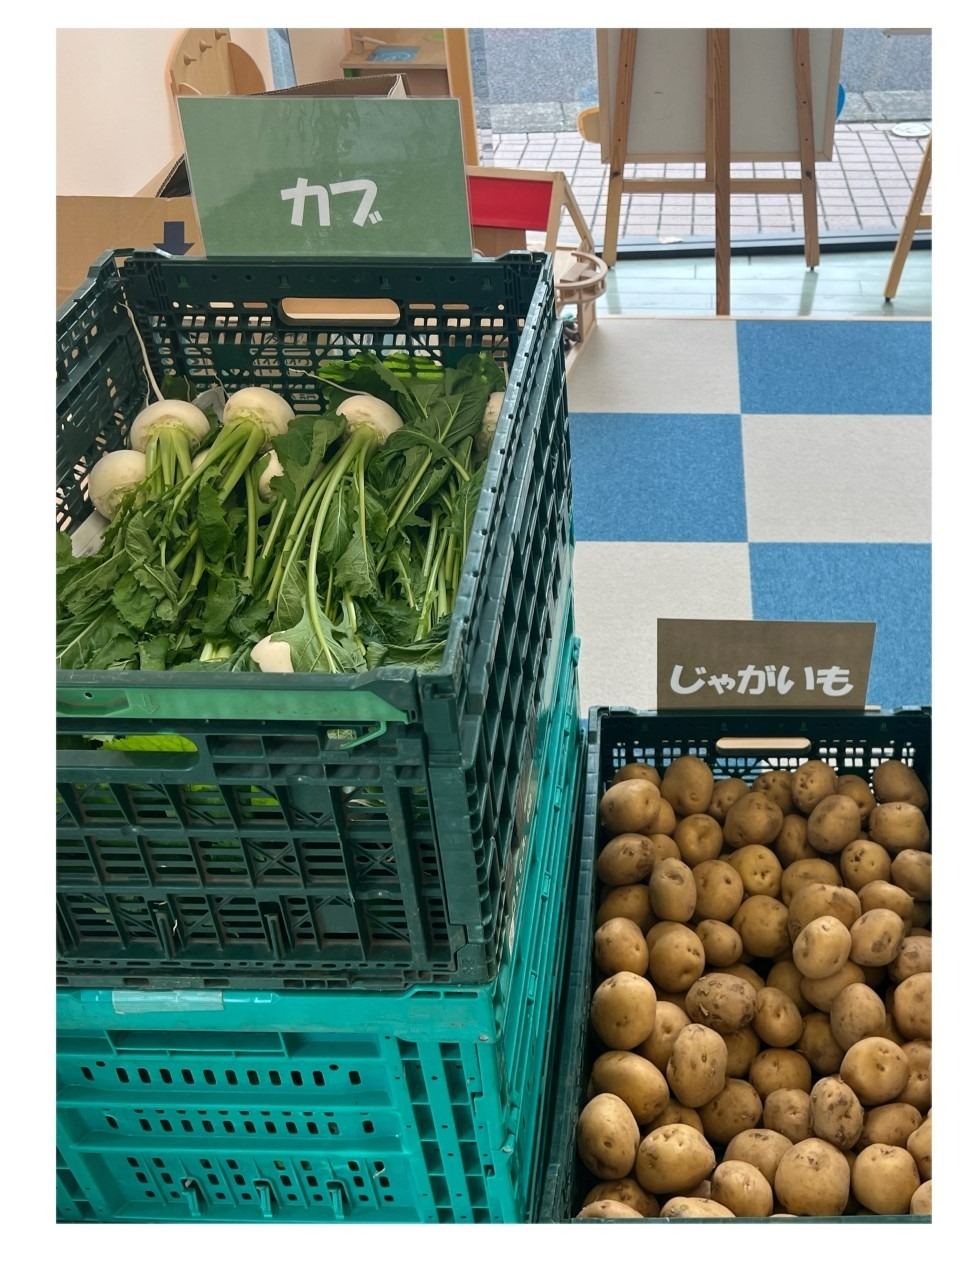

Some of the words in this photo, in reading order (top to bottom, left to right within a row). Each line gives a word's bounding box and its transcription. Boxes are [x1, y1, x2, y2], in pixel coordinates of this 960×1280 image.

[281, 176, 384, 228] カブ
[668, 663, 856, 697] じゃがいも
